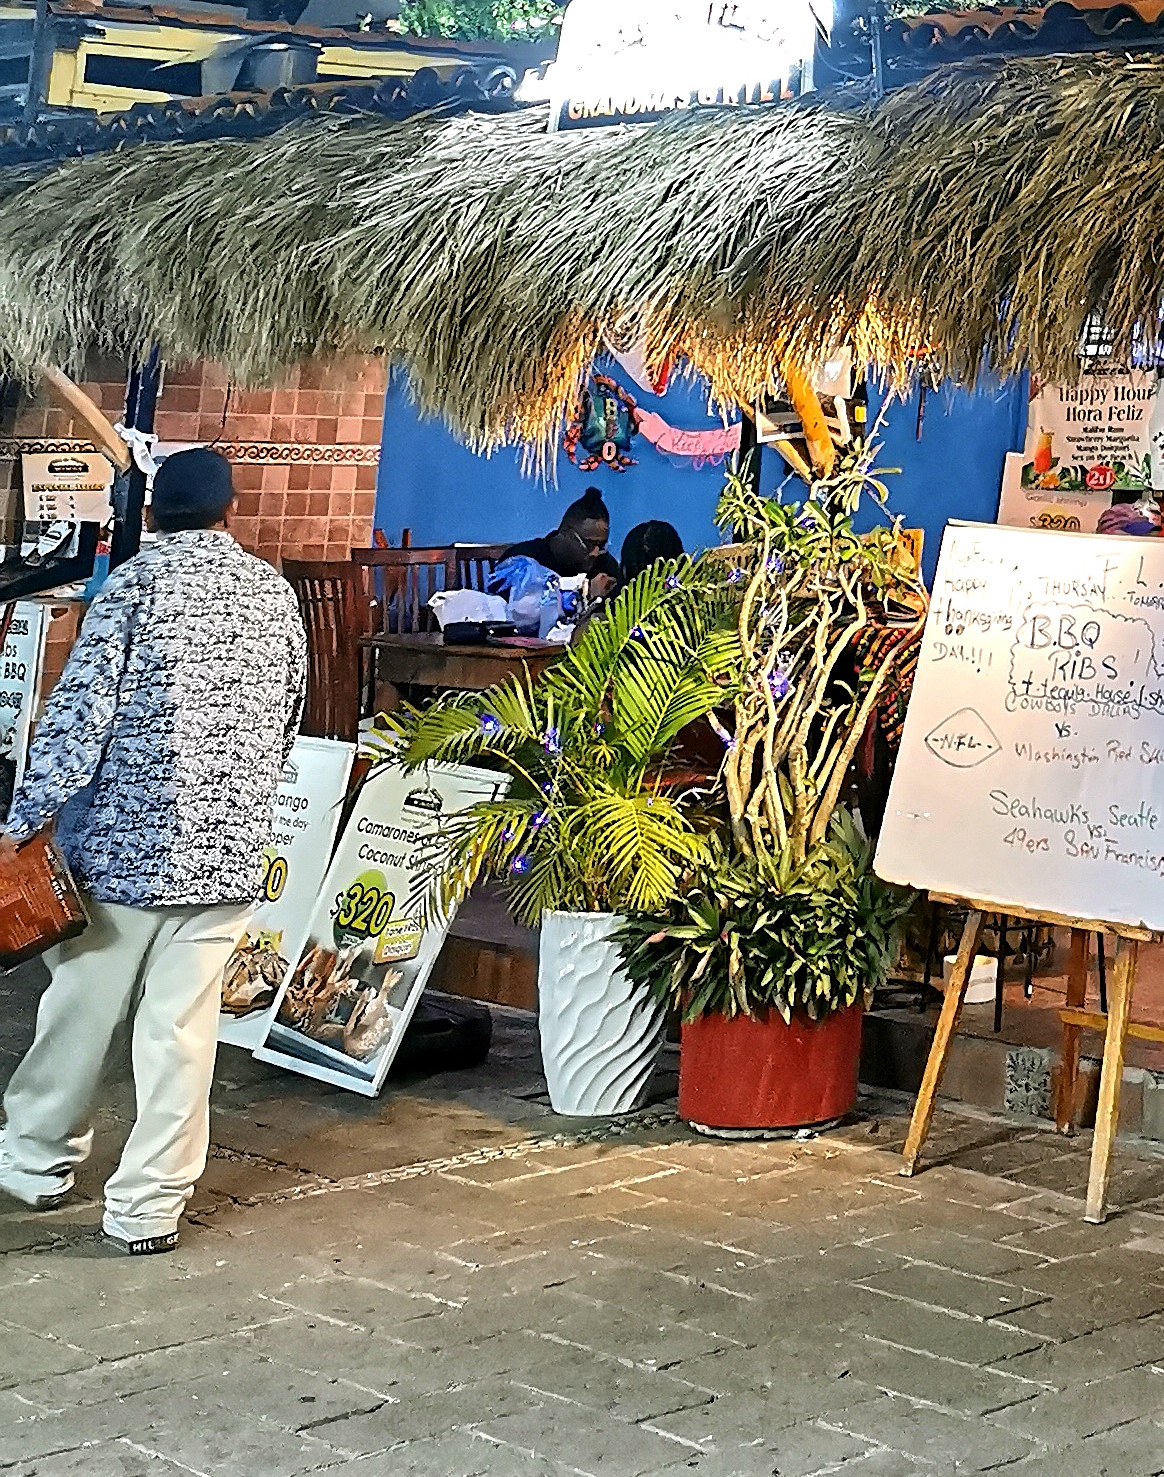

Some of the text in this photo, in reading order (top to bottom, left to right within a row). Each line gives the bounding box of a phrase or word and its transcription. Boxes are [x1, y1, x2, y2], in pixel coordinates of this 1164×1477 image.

[1059, 386, 1153, 405] Happy Hour
[1066, 404, 1144, 421] Hora Feliz
[358, 842, 408, 869] Coconut
[329, 881, 396, 939] $320
